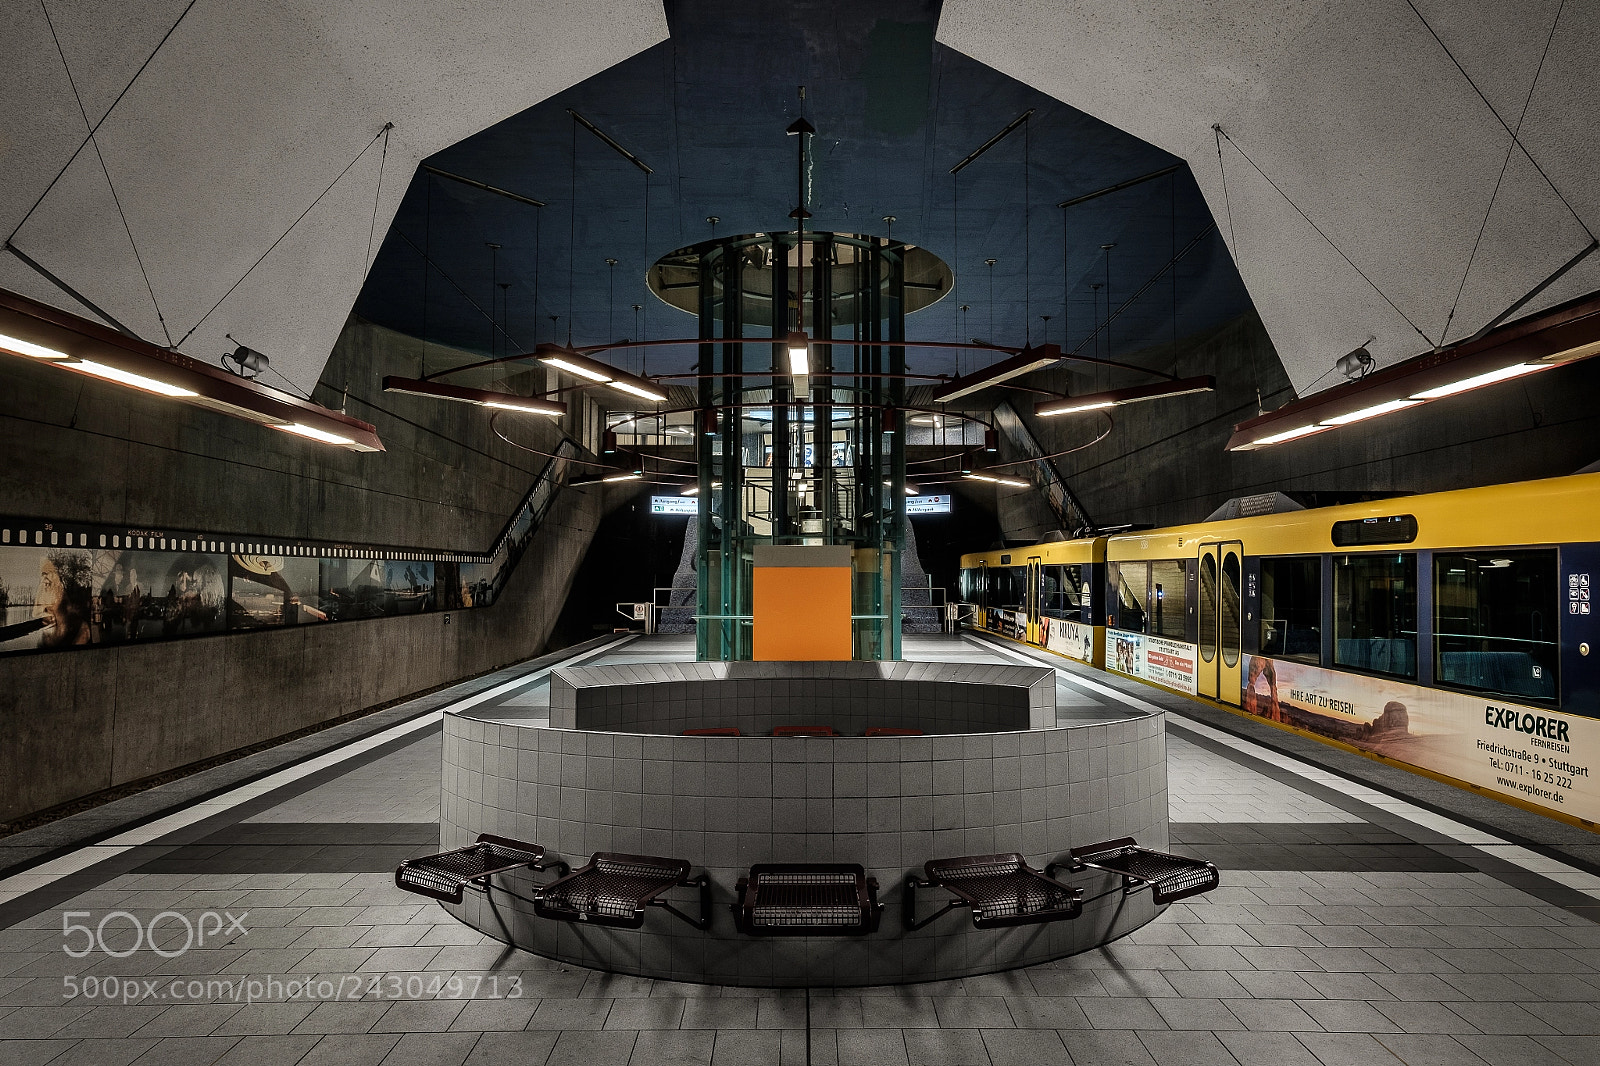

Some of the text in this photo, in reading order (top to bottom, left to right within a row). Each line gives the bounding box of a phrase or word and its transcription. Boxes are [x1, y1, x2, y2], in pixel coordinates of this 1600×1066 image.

[127, 529, 149, 537] KODAK
[1290, 688, 1356, 716] IHRE ART ZU REISEN.
[1485, 705, 1570, 742] EXPLORER
[1476, 739, 1589, 778] Friedrichstraße 9 Stuttgart
[1530, 737, 1570, 754] FERNREISEN
[1496, 776, 1564, 803] www.explorer.de
[1504, 761, 1523, 776] 0711
[1531, 769, 1542, 781] 16
[1544, 772, 1554, 784] 25
[1556, 775, 1573, 790] 222
